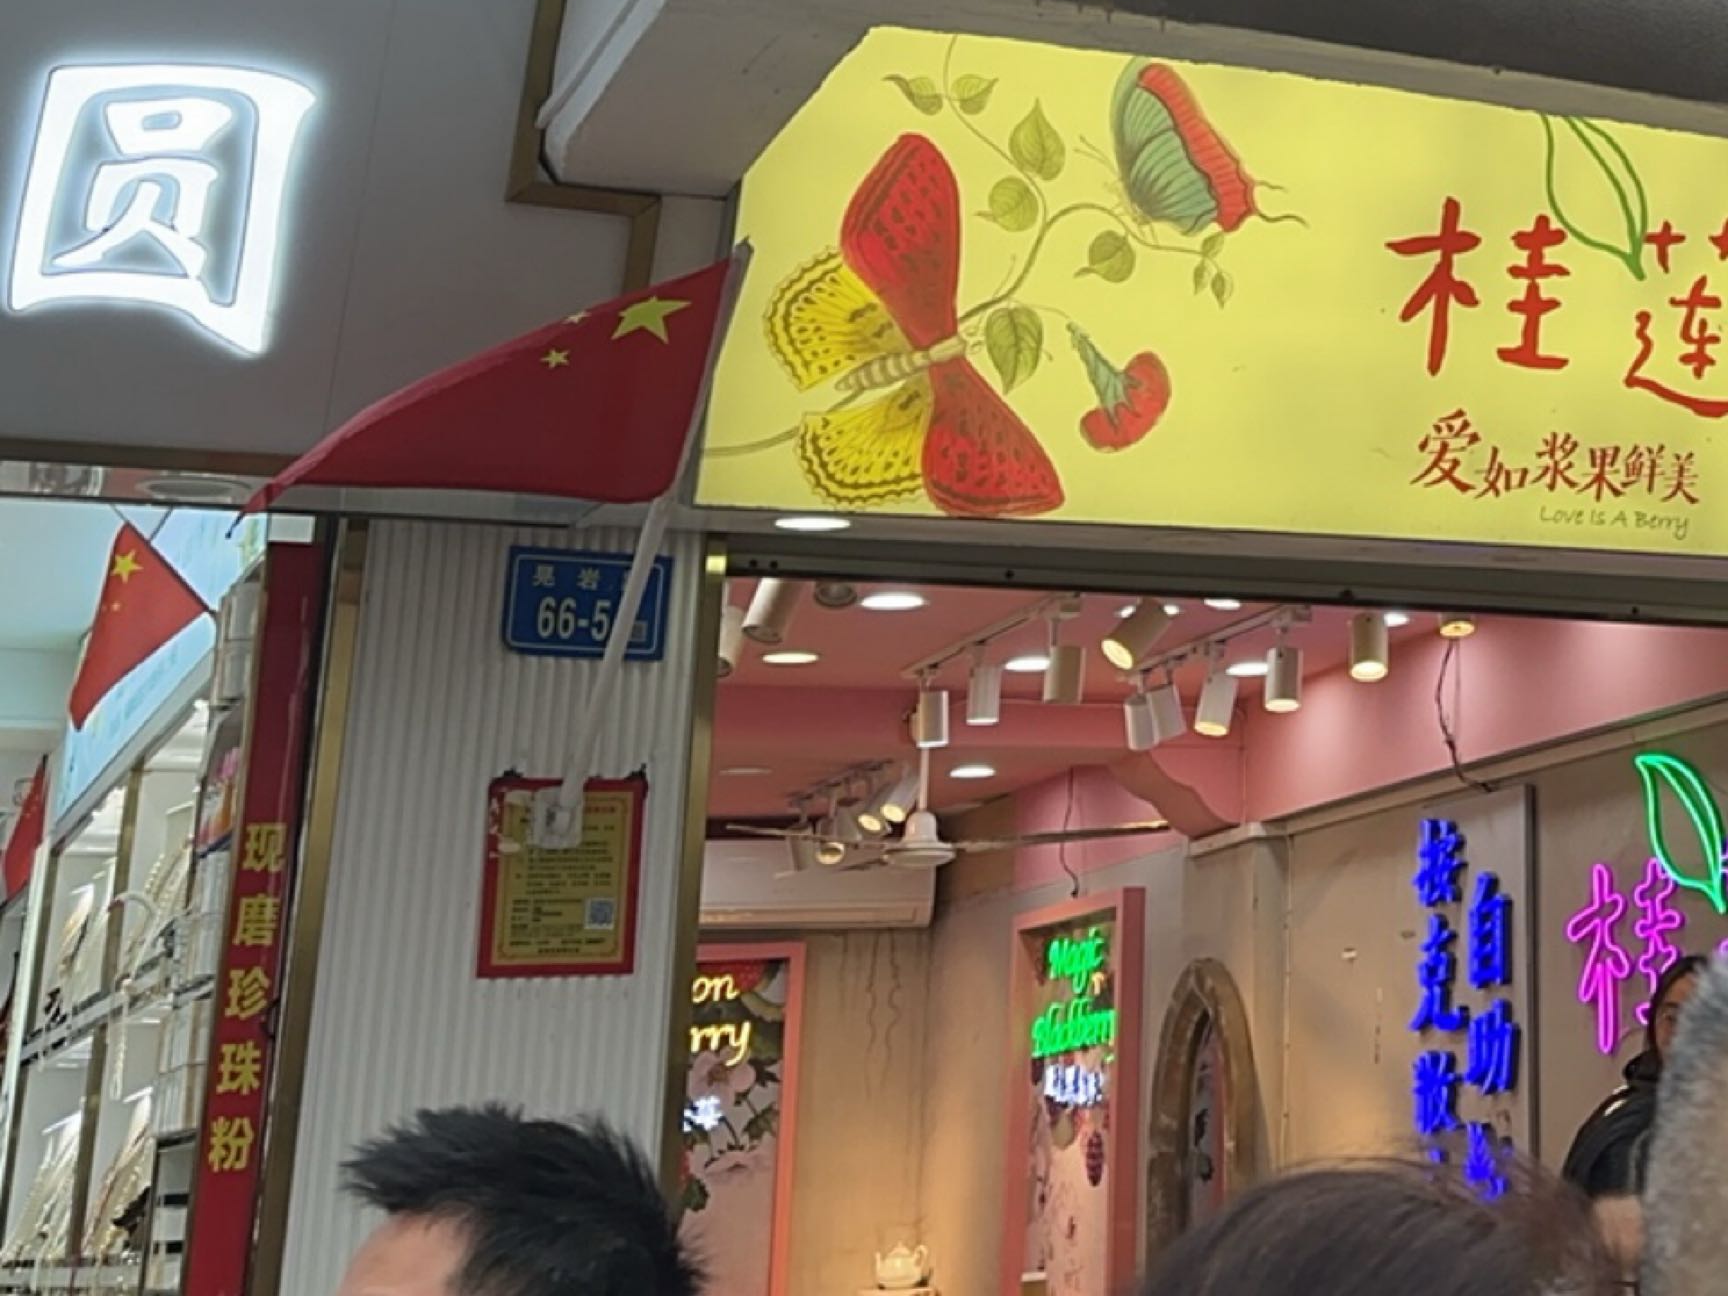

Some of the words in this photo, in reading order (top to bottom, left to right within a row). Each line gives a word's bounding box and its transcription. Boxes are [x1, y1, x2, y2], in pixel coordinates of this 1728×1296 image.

[6, 64, 316, 356] 圆
[1409, 408, 1700, 505] 爱如浆果鲜美
[1539, 506, 1585, 526] Love
[1611, 510, 1628, 528] A
[1634, 511, 1690, 541] Berry
[531, 563, 634, 592] 晃岩
[537, 596, 612, 642] 66-5
[207, 822, 288, 1174] 现磨珍珠粉
[1411, 817, 1468, 1166] 按克散
